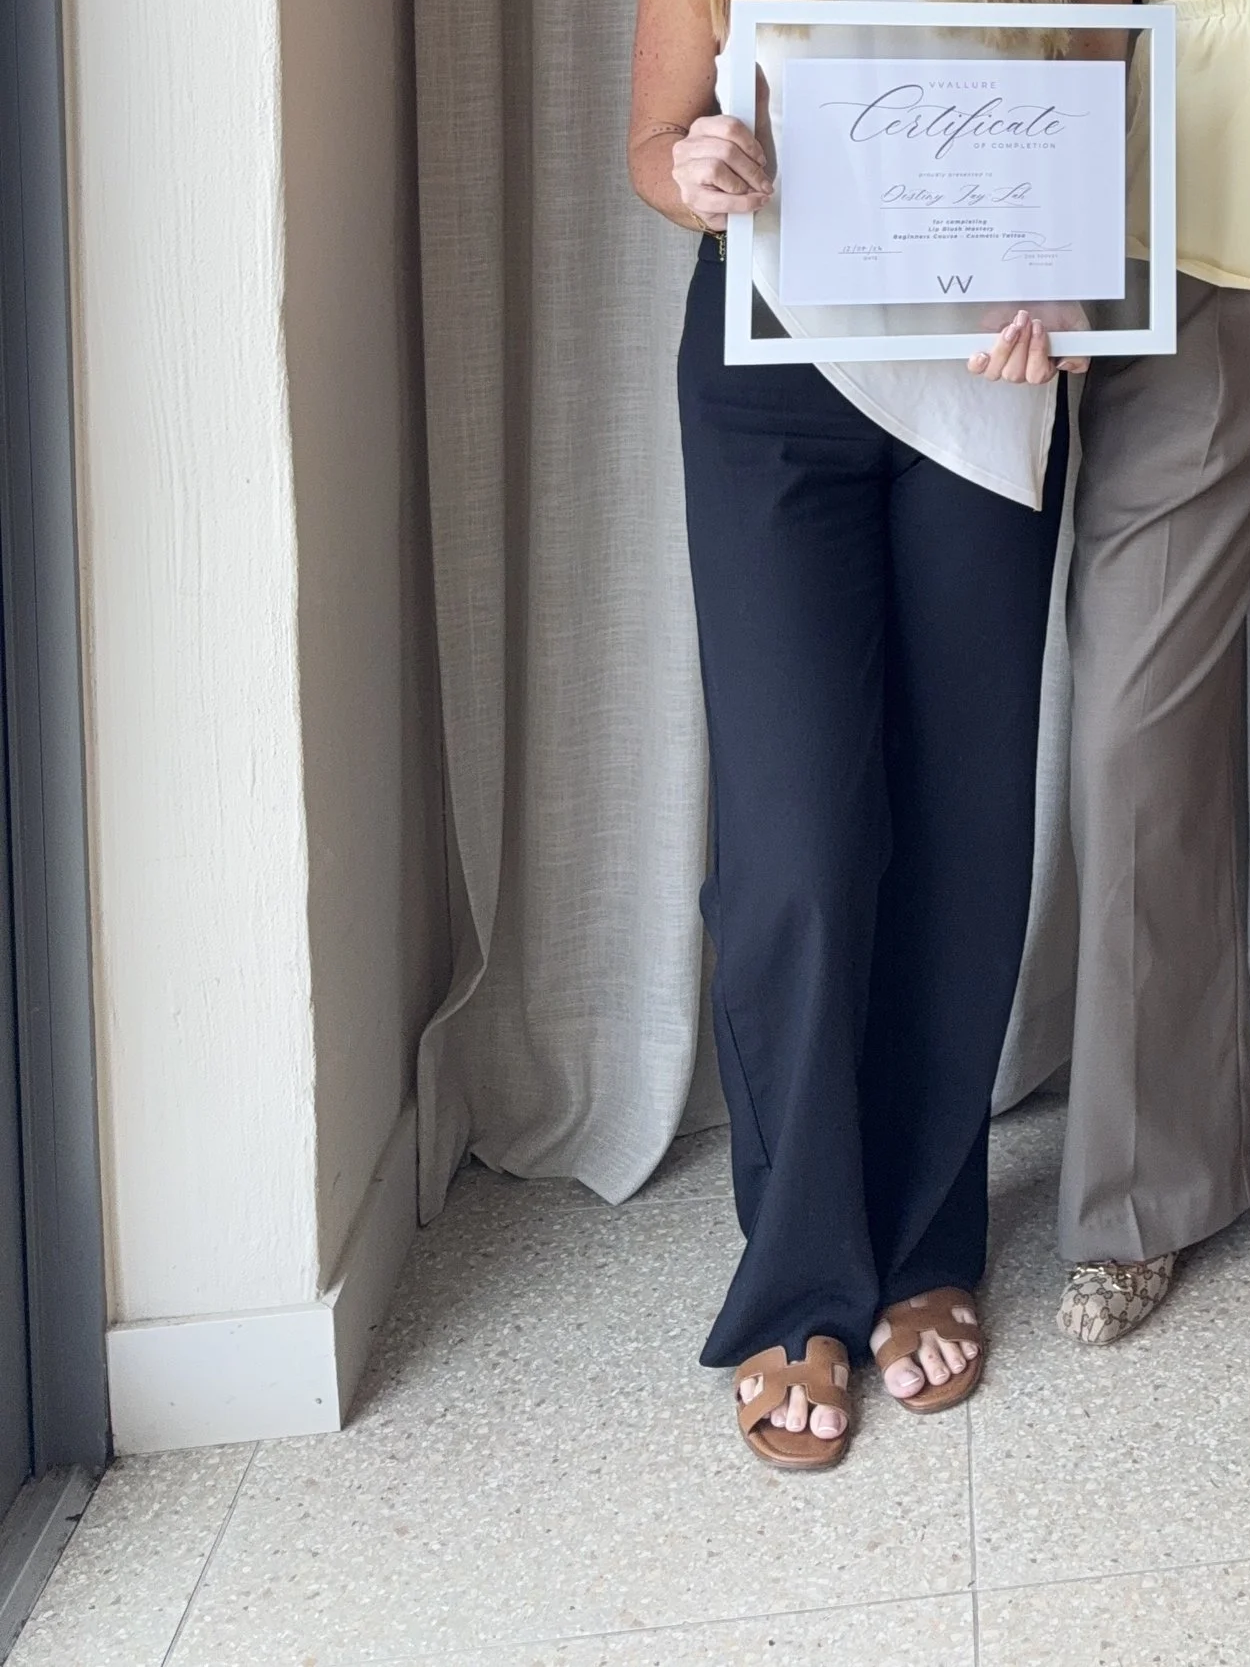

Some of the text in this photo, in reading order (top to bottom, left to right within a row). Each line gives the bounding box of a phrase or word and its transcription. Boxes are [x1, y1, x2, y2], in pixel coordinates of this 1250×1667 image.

[818, 84, 1091, 160] Certificate
[973, 142, 1056, 150] OF COMPLETION
